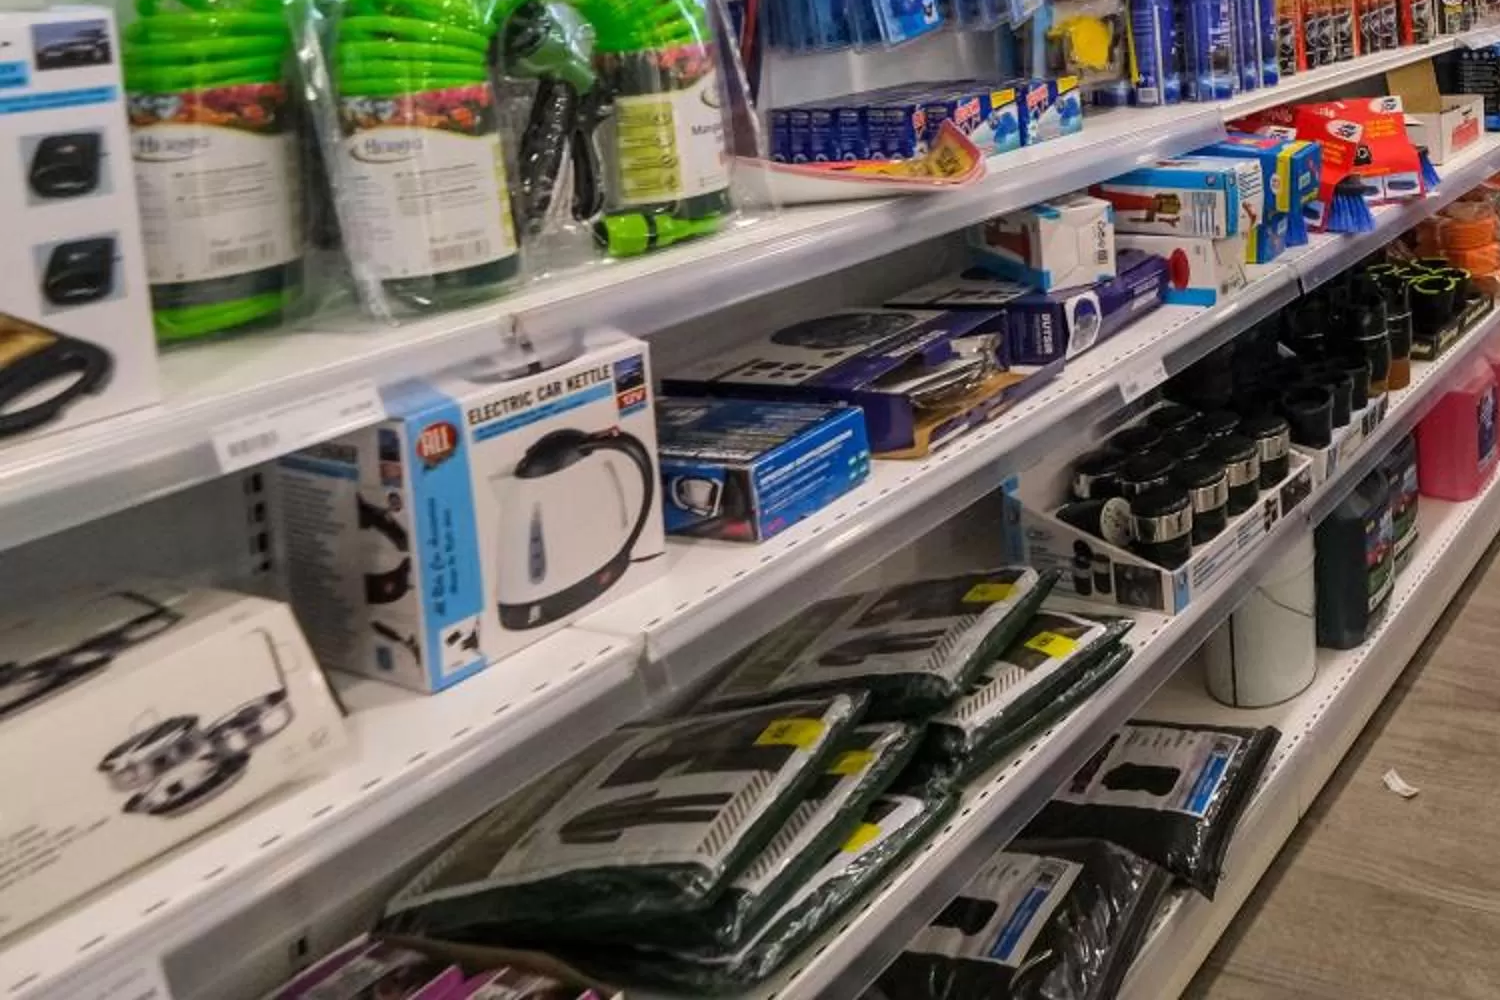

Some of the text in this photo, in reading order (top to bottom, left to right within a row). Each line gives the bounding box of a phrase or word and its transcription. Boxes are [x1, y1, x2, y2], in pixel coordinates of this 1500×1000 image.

[467, 363, 612, 426] ELECTRIC CAR KETTLE
[418, 423, 451, 457] ALL
